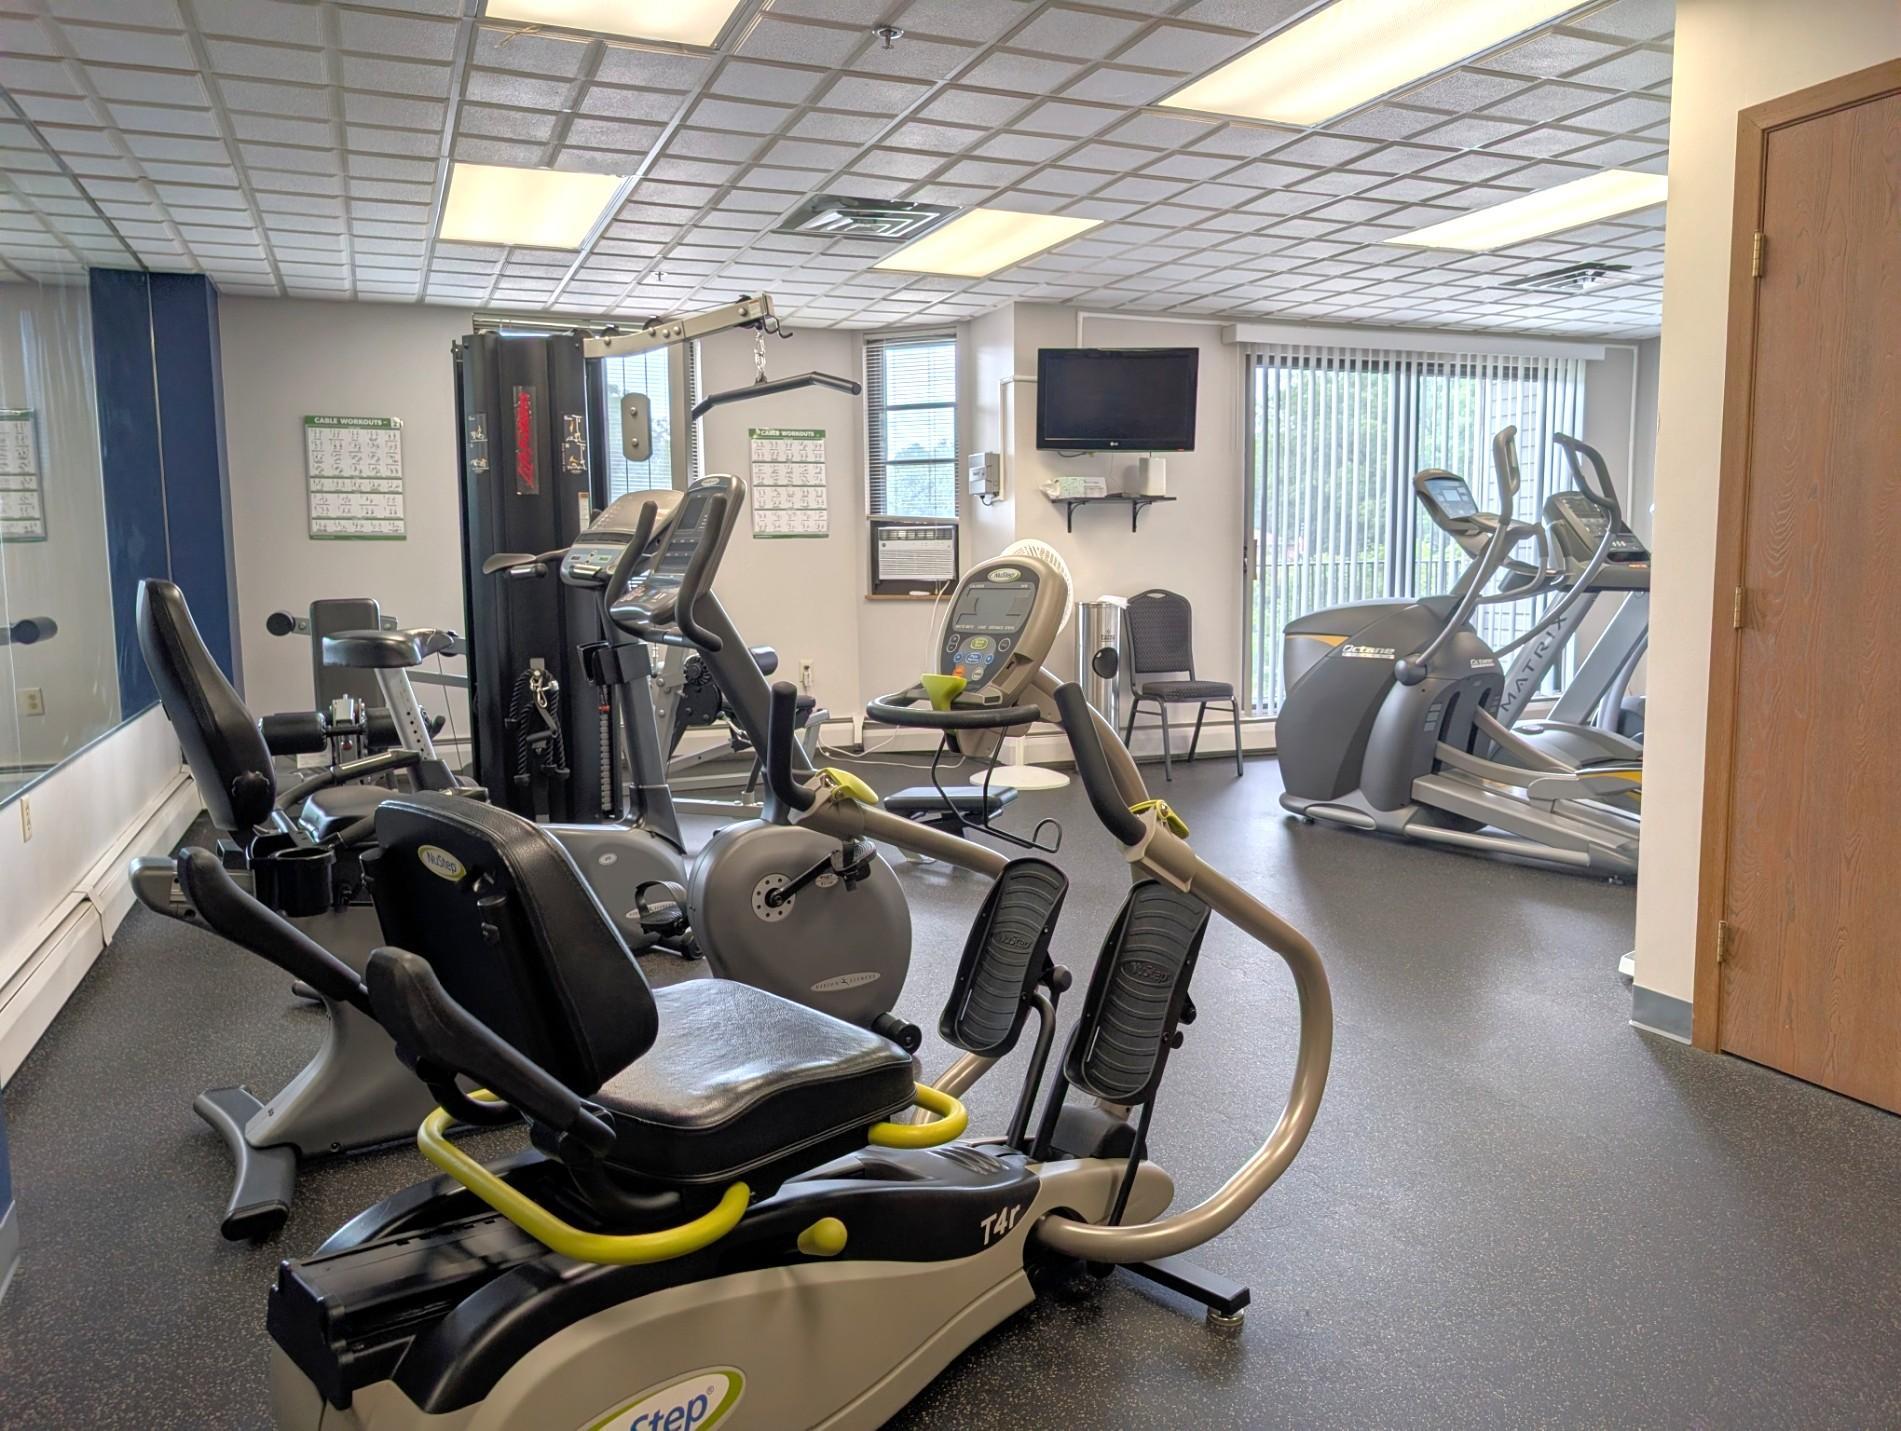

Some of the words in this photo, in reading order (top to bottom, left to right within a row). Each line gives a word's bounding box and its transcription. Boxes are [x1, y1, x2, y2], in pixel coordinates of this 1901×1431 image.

[314, 416, 338, 424] CABLE
[340, 417, 383, 426] WORKOUTS
[1342, 644, 1395, 655] Octane
[1500, 616, 1567, 712] MATRIX
[426, 851, 457, 873] NuStep
[980, 1204, 1021, 1246] T4r
